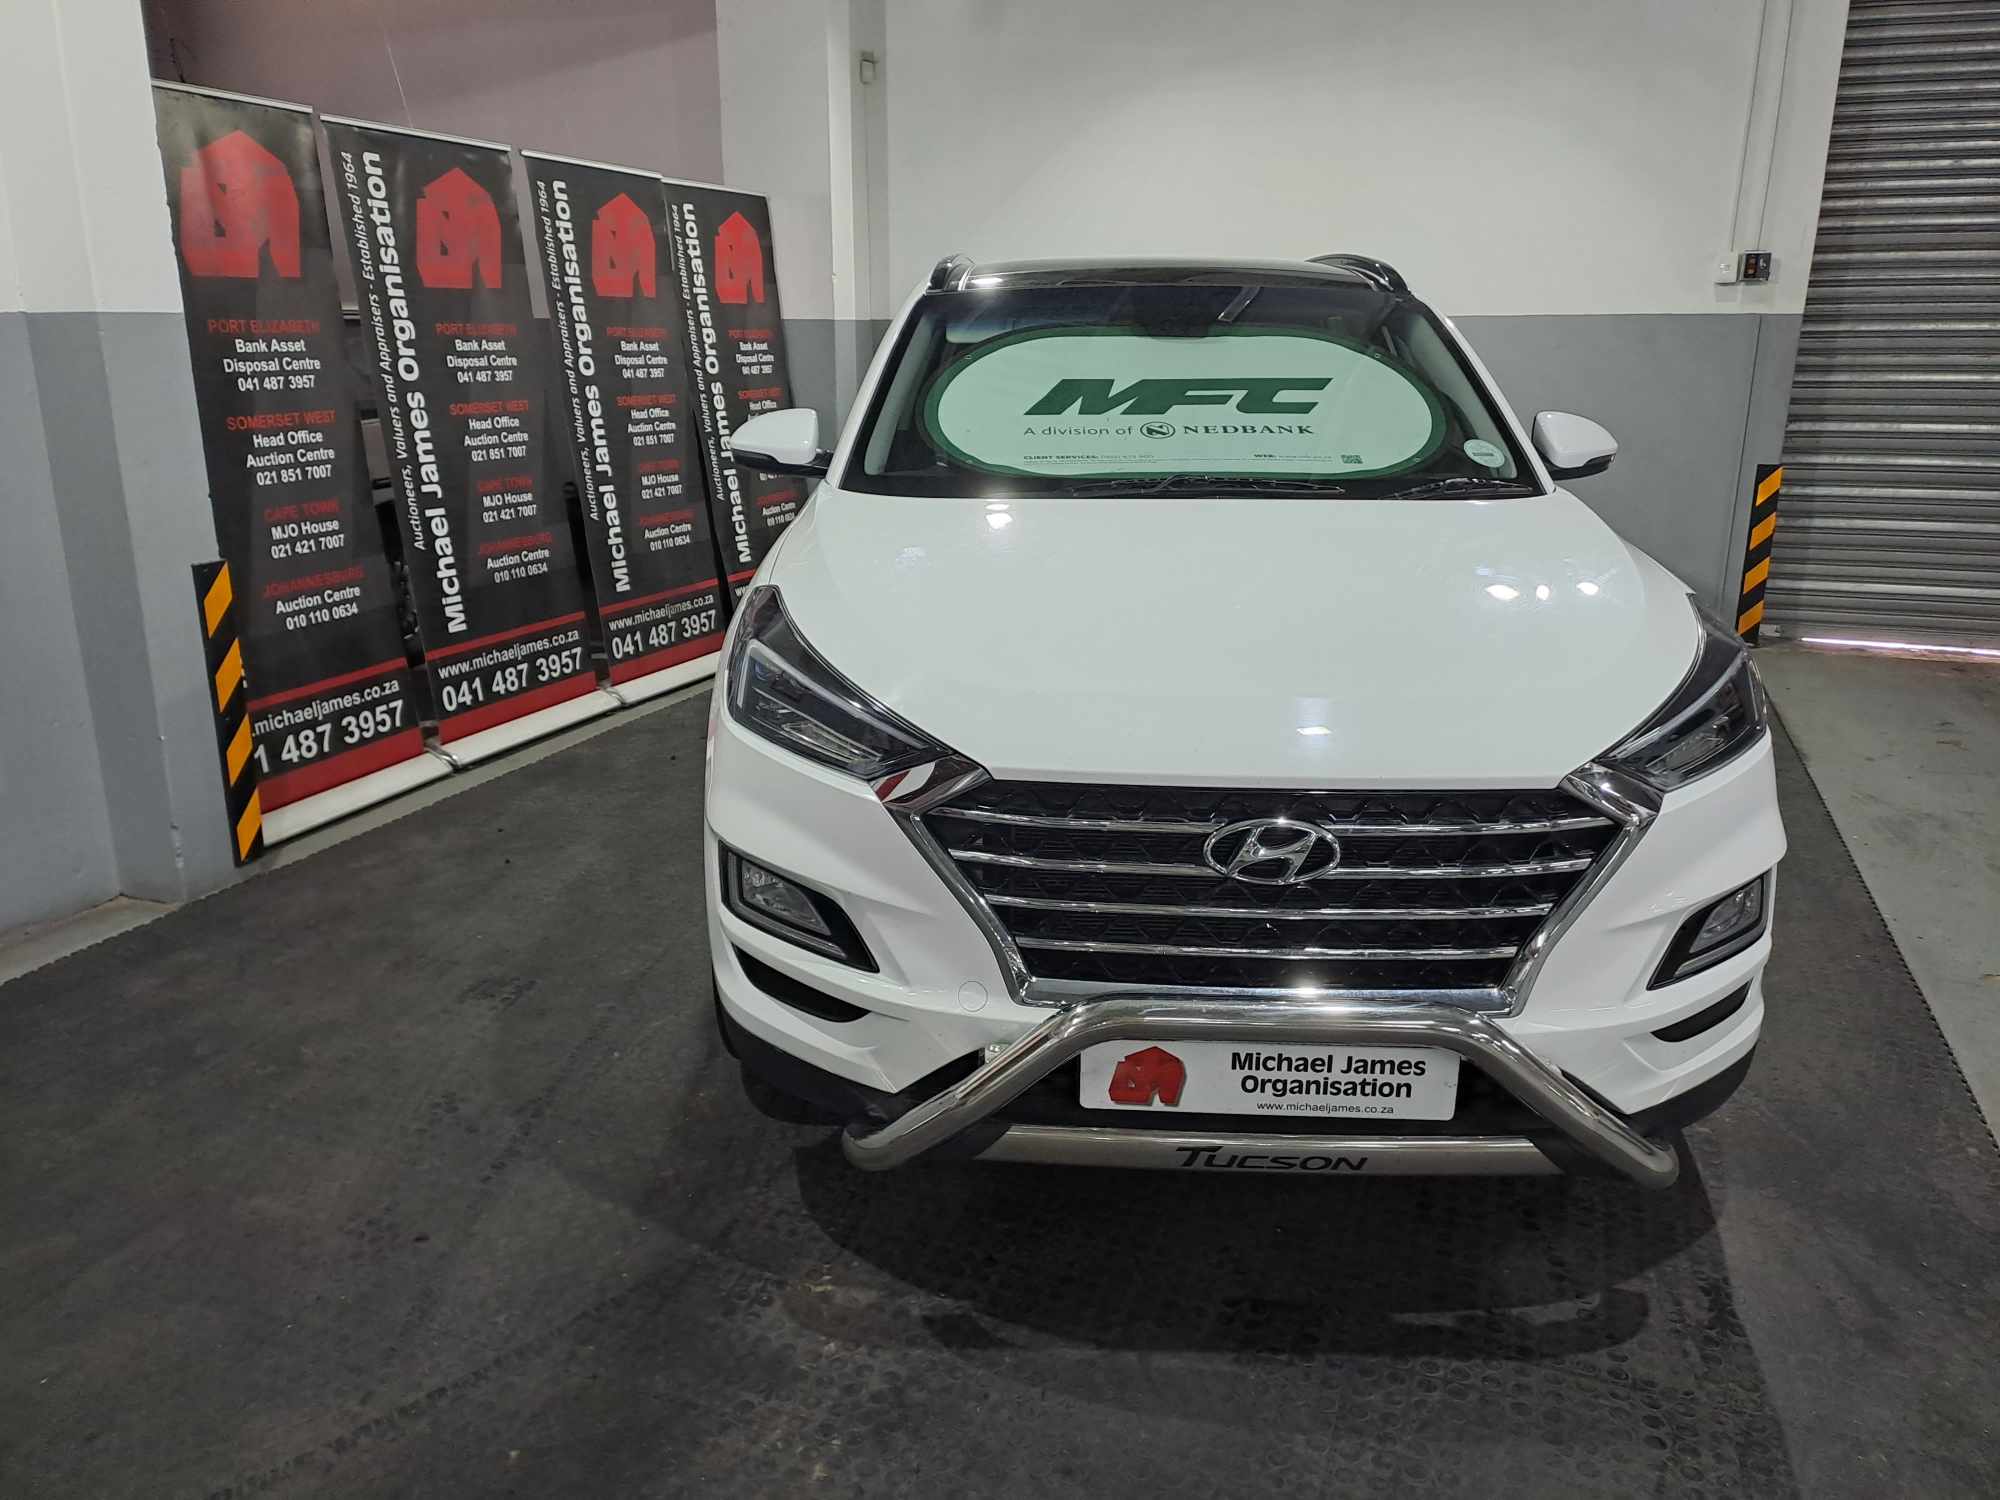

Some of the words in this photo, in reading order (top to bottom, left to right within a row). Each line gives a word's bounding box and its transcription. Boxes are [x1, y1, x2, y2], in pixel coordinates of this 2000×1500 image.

[340, 151, 359, 189] 1964
[536, 181, 550, 213] 1964
[347, 193, 375, 280] Established
[362, 151, 420, 382] Organisation
[541, 216, 562, 290] Established
[552, 180, 595, 377] Organisation
[683, 203, 719, 375] Organisation
[208, 320, 246, 333] PORT
[369, 292, 392, 371] Appraisers
[555, 301, 575, 367] Appraisers
[235, 339, 268, 353] Bank
[271, 339, 306, 352] Asset
[455, 339, 480, 351] Bank
[481, 339, 506, 351] Asset
[223, 358, 279, 374] Disposal
[282, 357, 321, 370] Centre
[447, 355, 488, 369] Disposal
[489, 354, 518, 366] Centre
[237, 378, 259, 391] 041
[263, 376, 284, 390] 487
[288, 375, 315, 389] 3957
[380, 373, 397, 402] and
[457, 372, 473, 383] 041
[476, 370, 491, 382] 487
[565, 369, 578, 394] and
[1023, 377, 1334, 415] MFC
[226, 412, 299, 430] SOMERSET
[390, 406, 408, 459] Valuers
[468, 417, 492, 430] Head
[494, 416, 520, 428] Office
[572, 397, 586, 443] Valuers
[585, 385, 612, 477] James
[711, 381, 735, 462] James
[1023, 426, 1035, 436] A
[1041, 425, 1109, 436] division
[1116, 425, 1133, 436] of
[1184, 425, 1314, 435] NEDBANK
[253, 432, 285, 448] Head
[287, 430, 323, 444] Office
[407, 391, 442, 499] James
[464, 433, 499, 447] Auction
[501, 432, 529, 443] Centre
[246, 451, 294, 468] Auction
[297, 448, 335, 462] Centre
[472, 450, 487, 462] 021
[507, 445, 527, 458] 7007
[256, 472, 277, 486] 021
[281, 468, 302, 483] 851
[305, 464, 332, 479] 7007
[401, 464, 425, 550] Auctioneers,
[483, 494, 503, 508] MJO
[504, 492, 533, 504] House
[483, 511, 498, 523] 021
[500, 508, 515, 520] 421
[517, 504, 537, 517] 7007
[271, 523, 298, 540] MJO
[301, 520, 339, 534] House
[723, 469, 752, 563] Michael
[271, 545, 292, 559] 021
[295, 539, 316, 554] 421
[319, 534, 345, 550] 7007
[599, 484, 631, 593] Michael
[425, 507, 468, 633] Michael
[487, 554, 520, 570] Auction
[521, 549, 550, 562] Centre
[494, 571, 509, 583] 010
[511, 567, 526, 579] 110
[527, 562, 548, 576] 0634
[276, 595, 322, 614] Auction
[324, 586, 361, 603] Centre
[286, 615, 307, 631] 010
[309, 609, 330, 625] 110
[332, 602, 359, 620] 0634
[612, 631, 643, 659] 041
[648, 621, 677, 647] 487
[681, 609, 716, 638] 3957
[438, 629, 580, 680] www.michaeljames.co.za
[442, 677, 484, 712] 041
[492, 662, 528, 695] 487
[536, 647, 582, 682] 3957
[252, 679, 400, 737] .michaeljames.co.za
[280, 722, 332, 763] 487
[341, 699, 403, 744] 3957
[1231, 1051, 1333, 1073] Michael
[1341, 1055, 1426, 1076] James
[1241, 1074, 1412, 1098] Organisation
[1256, 1101, 1394, 1115] www.michaeljames.co.za
